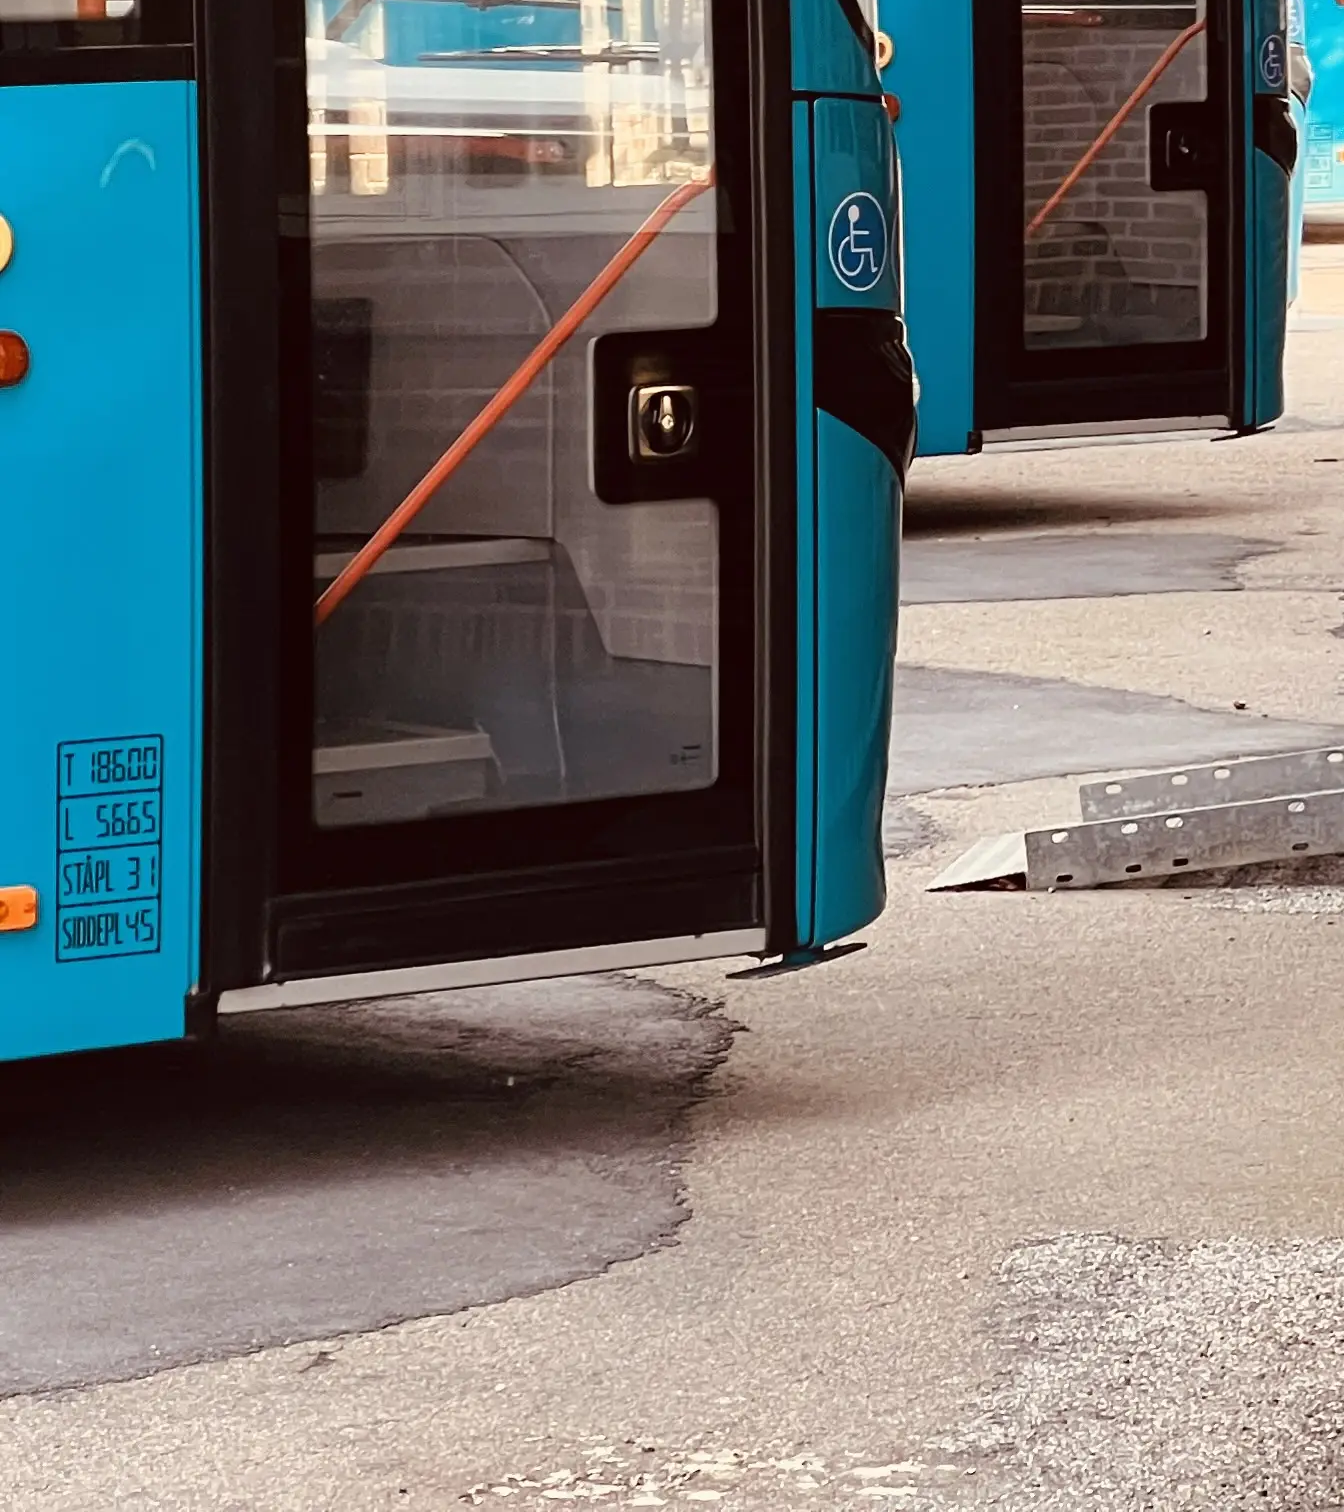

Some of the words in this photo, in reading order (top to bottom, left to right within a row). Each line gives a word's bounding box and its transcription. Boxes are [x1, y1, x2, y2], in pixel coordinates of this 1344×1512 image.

[64, 753, 75, 786] T
[91, 747, 157, 784] 18600
[65, 808, 74, 841] L
[96, 801, 156, 838] 5665
[63, 855, 115, 896] STÅPL
[63, 912, 123, 950] SIDDEPL
[126, 909, 154, 942] 45
